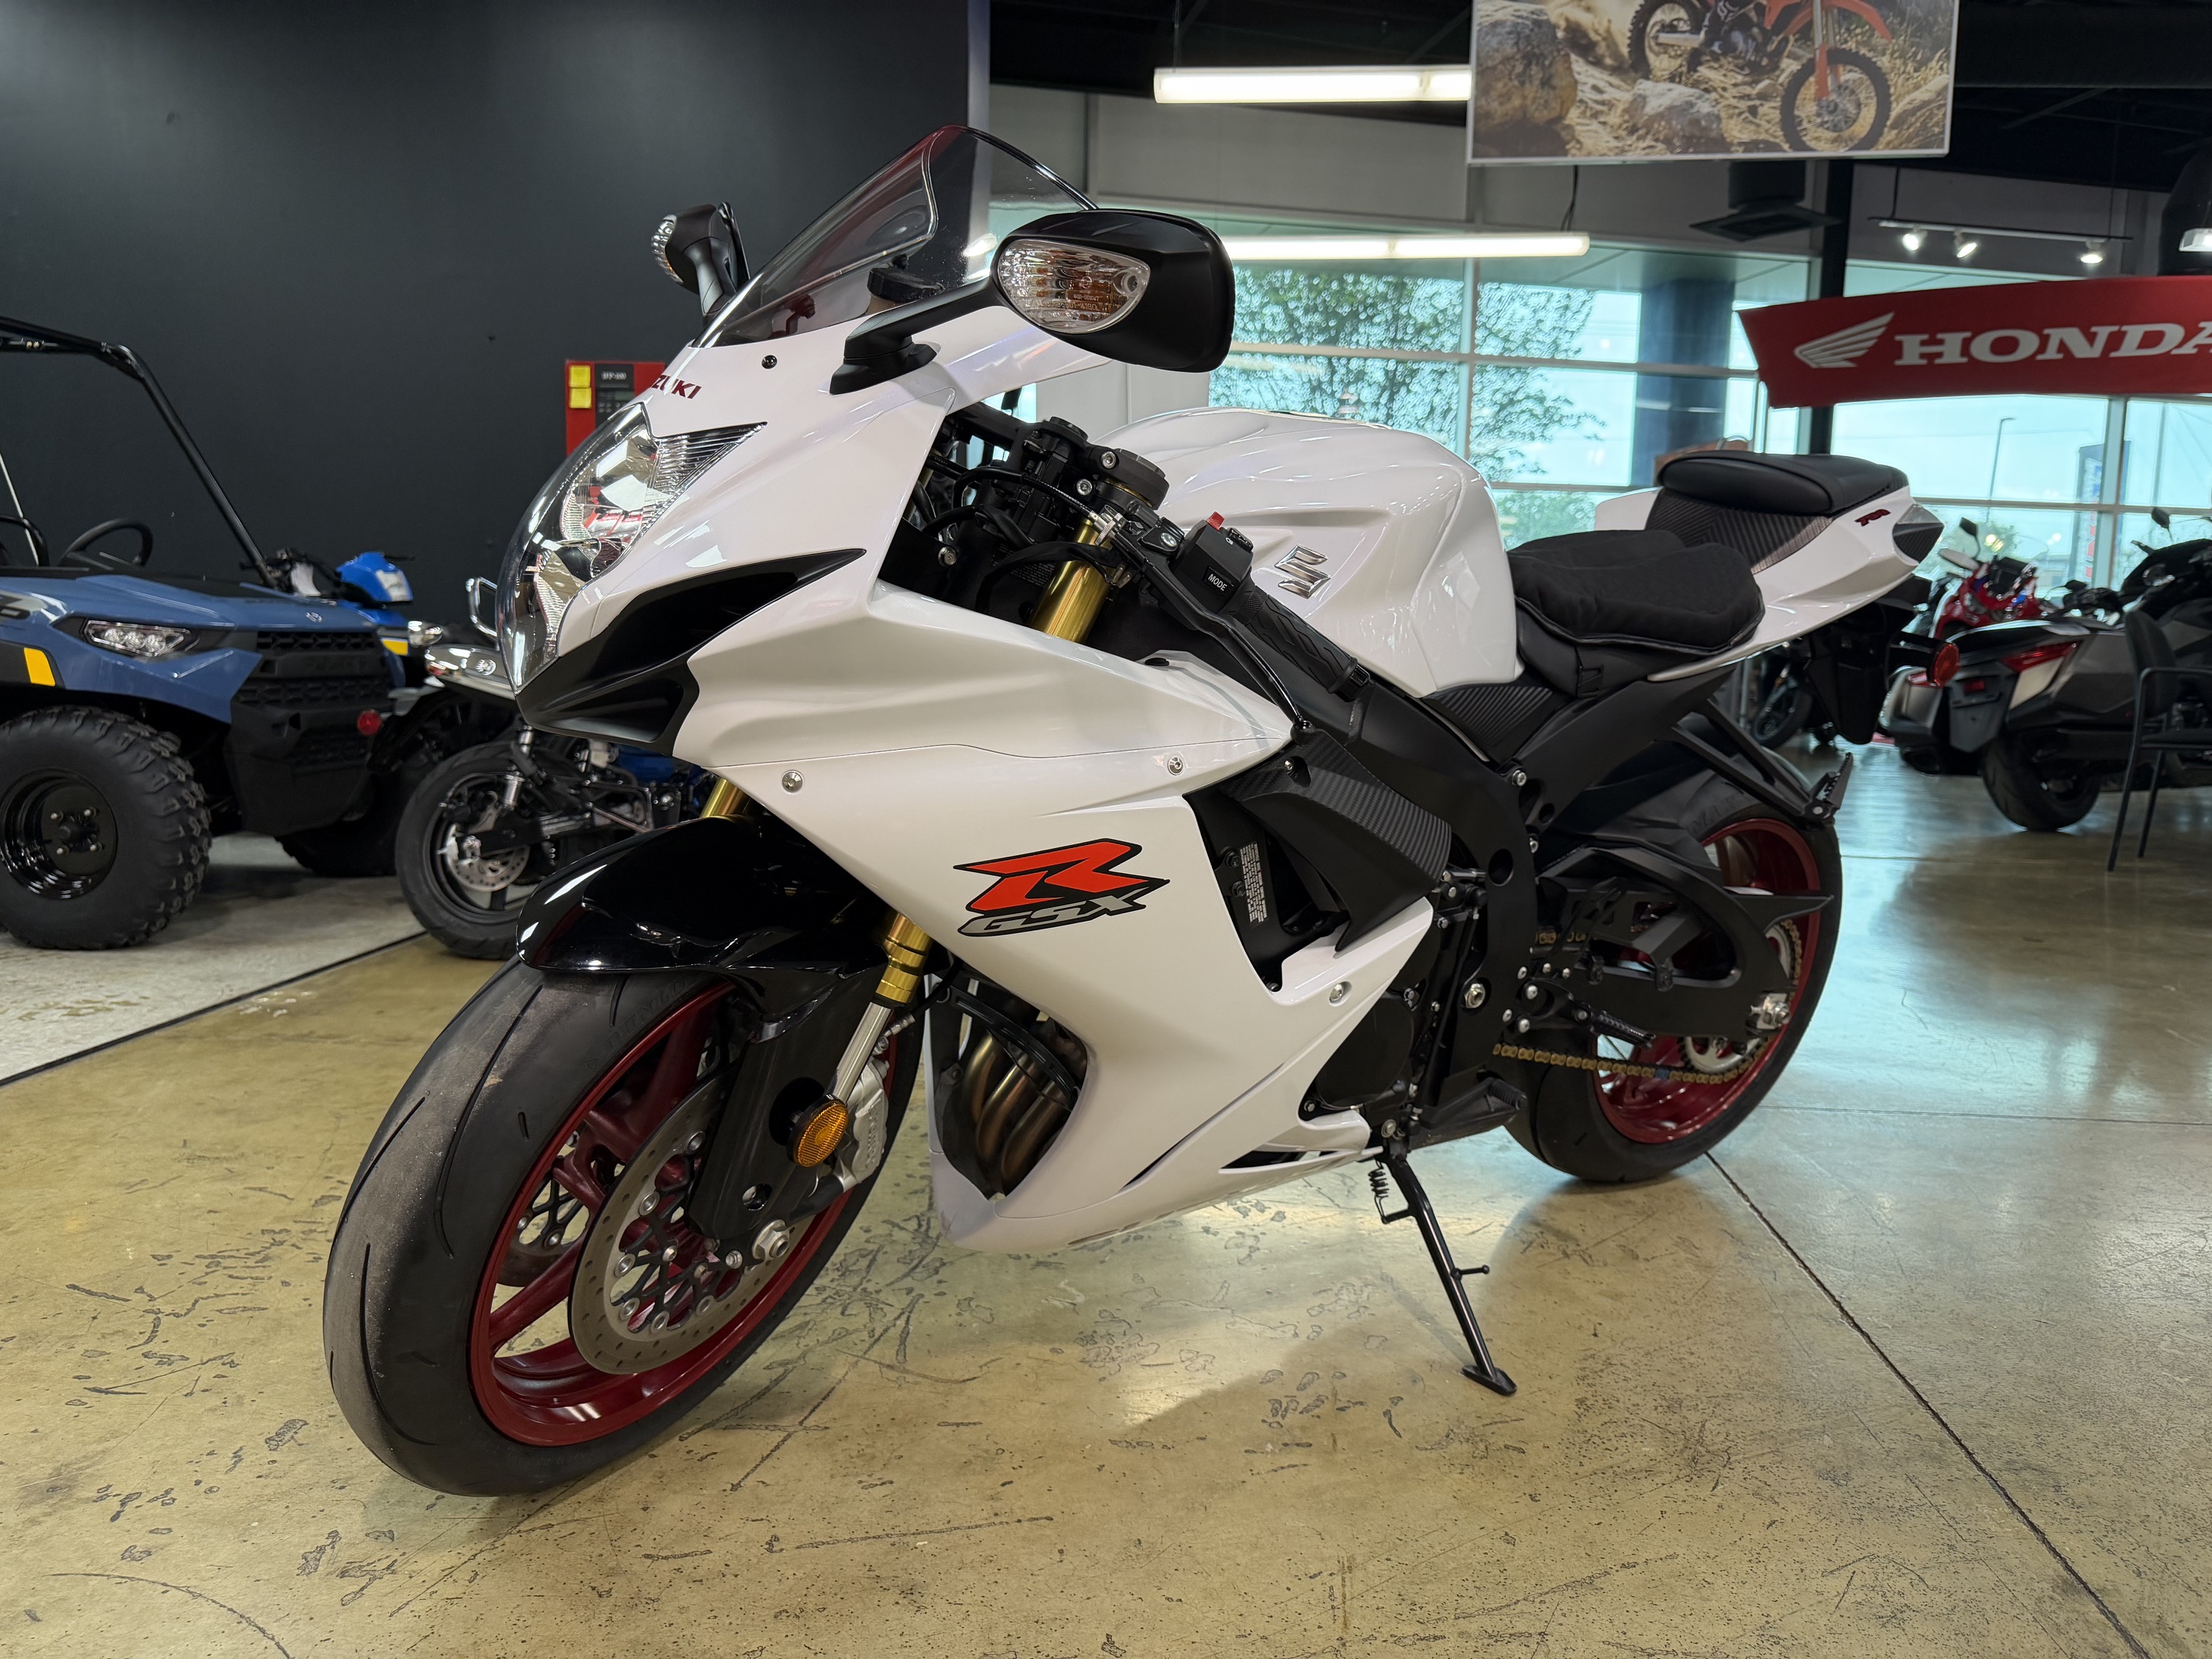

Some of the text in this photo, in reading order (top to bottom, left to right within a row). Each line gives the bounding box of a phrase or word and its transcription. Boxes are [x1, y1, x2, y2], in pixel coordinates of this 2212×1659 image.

[1894, 321, 2212, 366] HONDA
[651, 374, 702, 400] ZUKI
[1208, 573, 1228, 592] MODE
[959, 886, 1151, 936] GSX
